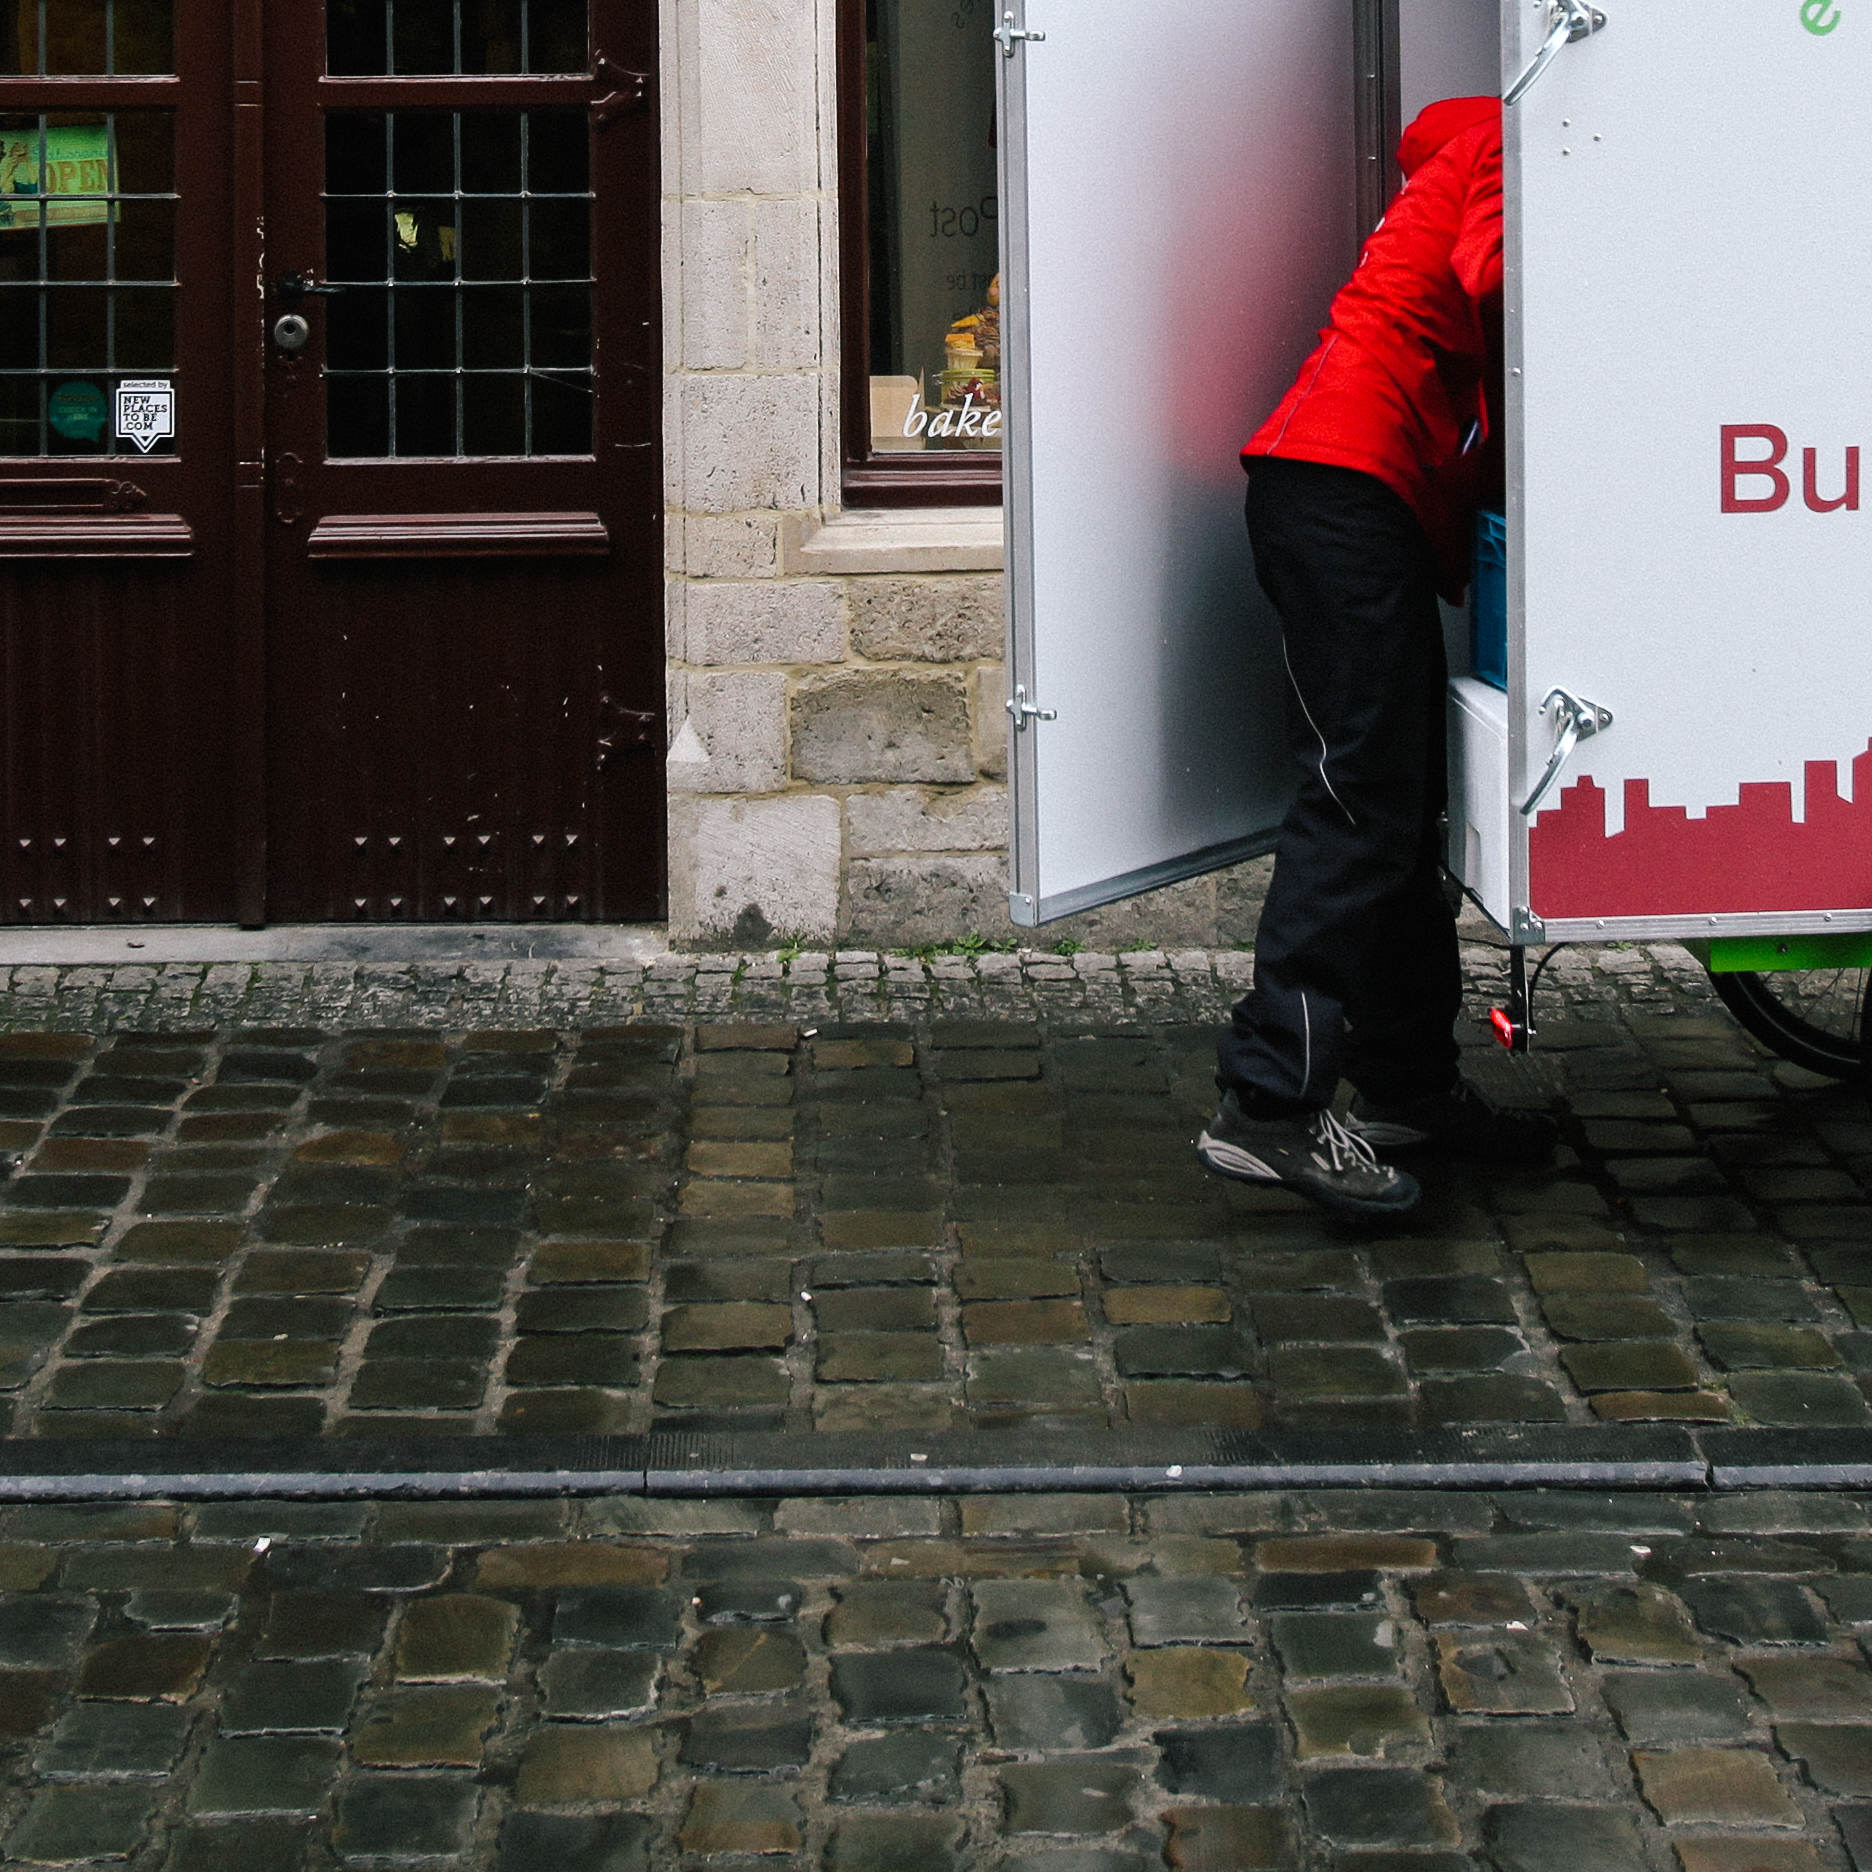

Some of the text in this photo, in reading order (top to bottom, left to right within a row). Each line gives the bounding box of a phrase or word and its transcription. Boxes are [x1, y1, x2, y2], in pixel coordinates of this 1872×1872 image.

[158, 381, 169, 389] by
[124, 395, 151, 404] NEW
[124, 404, 168, 413] PLACES
[123, 413, 157, 421] TO BE
